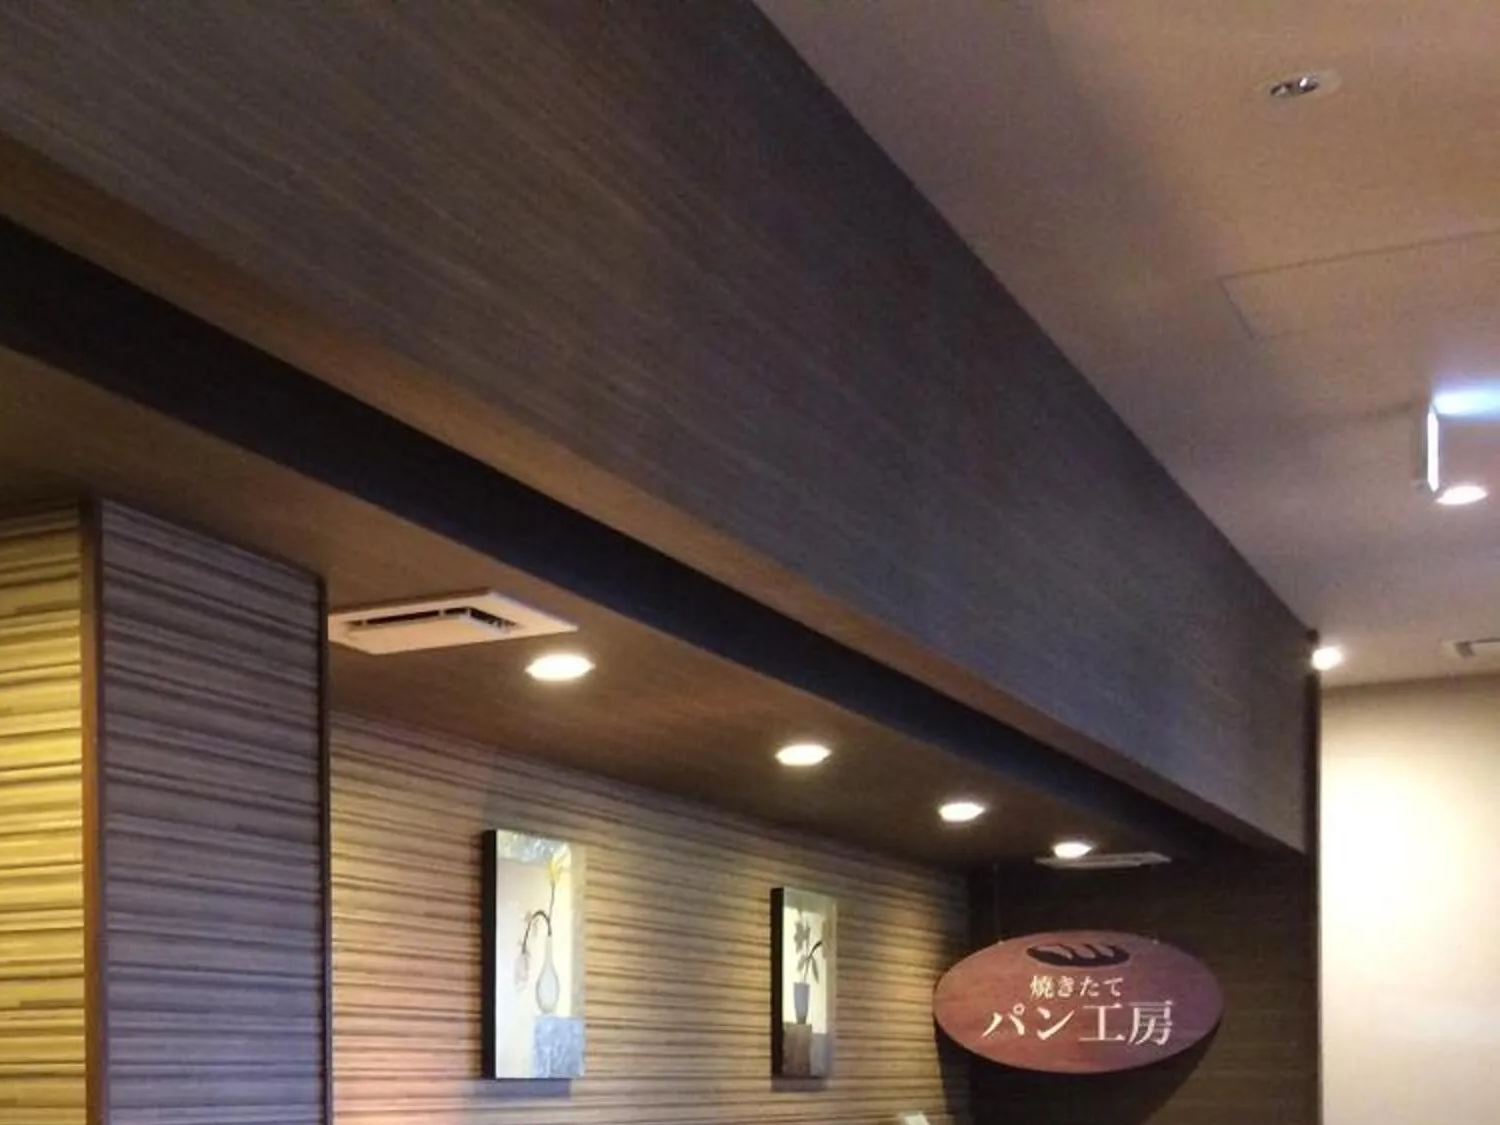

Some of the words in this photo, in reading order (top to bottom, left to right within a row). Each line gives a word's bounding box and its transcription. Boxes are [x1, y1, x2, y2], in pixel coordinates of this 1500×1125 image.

[1029, 974, 1125, 999] 焼きたて
[980, 999, 1174, 1046] パン工房
